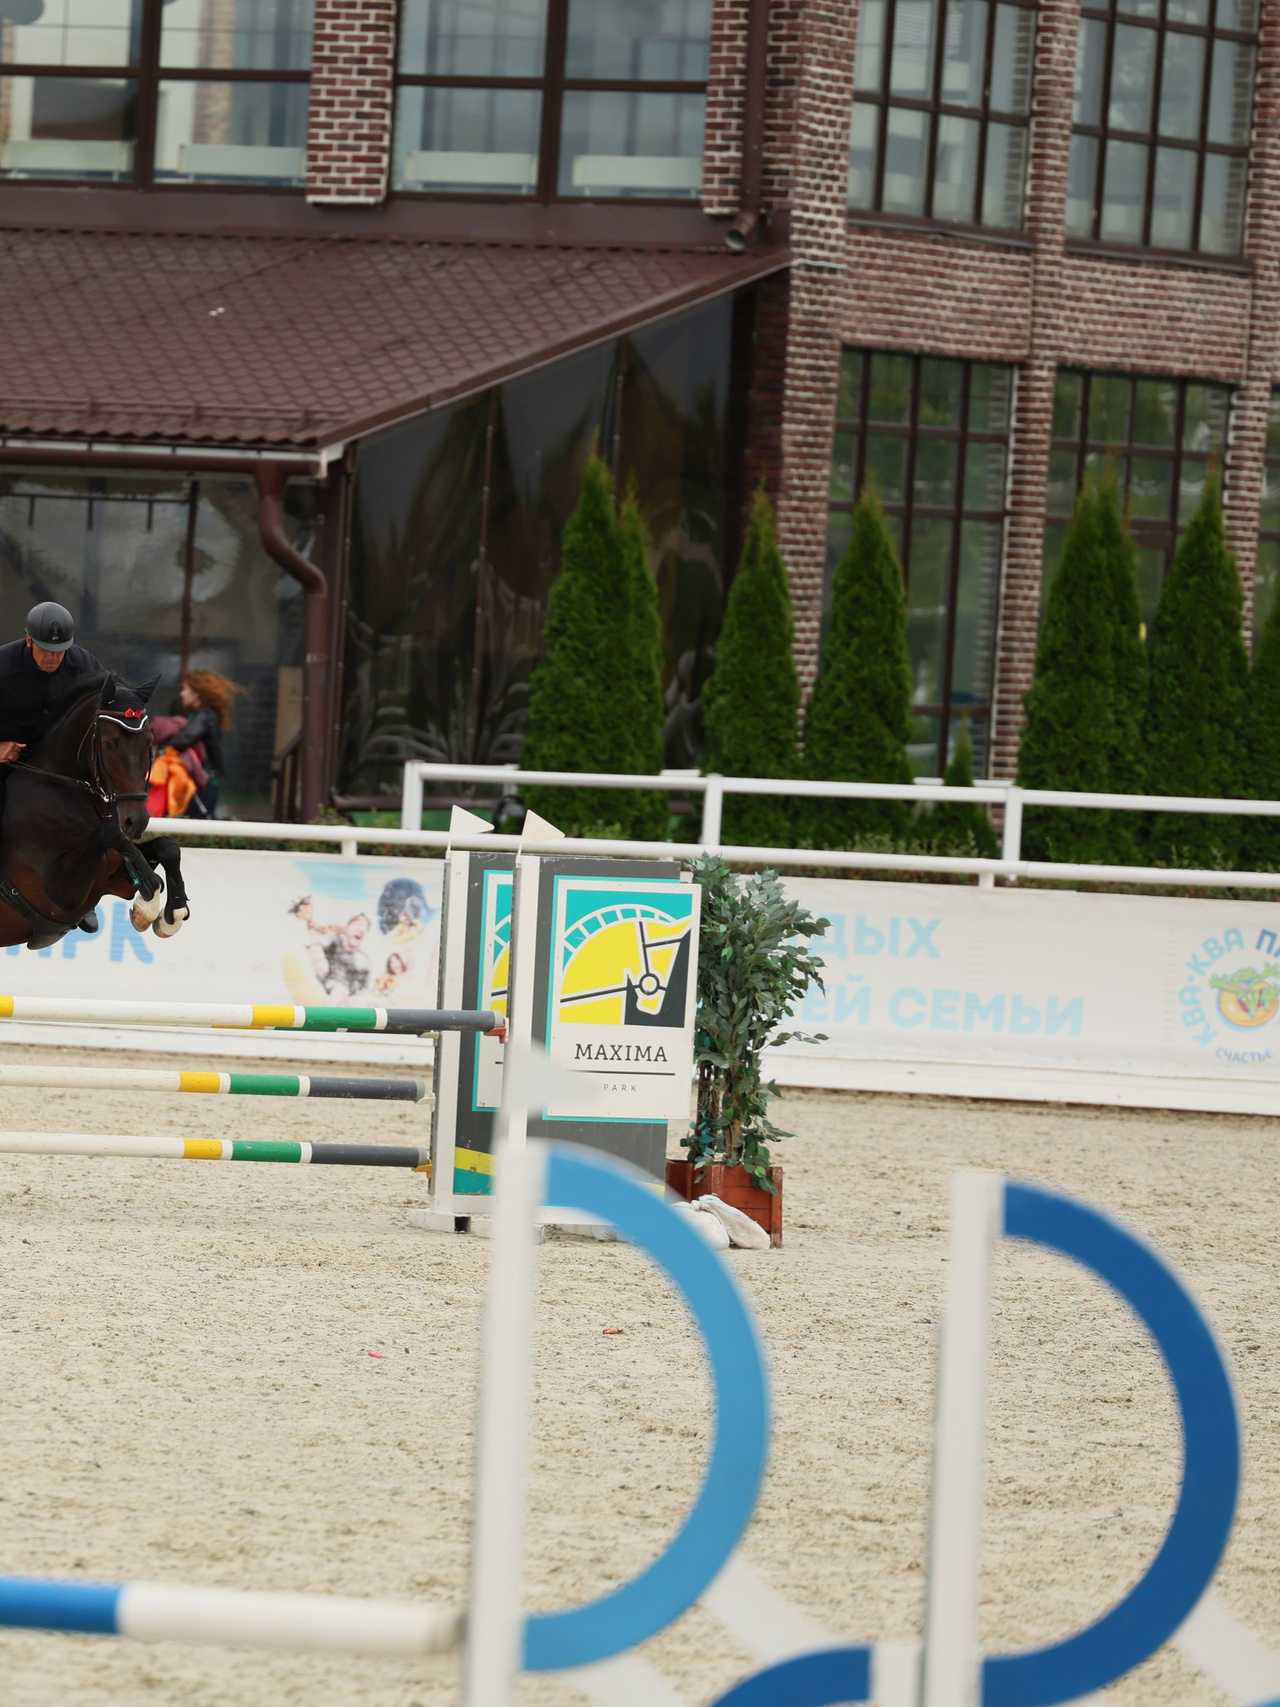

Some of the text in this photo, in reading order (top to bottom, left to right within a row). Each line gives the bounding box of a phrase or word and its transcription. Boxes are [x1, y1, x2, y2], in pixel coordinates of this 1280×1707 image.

[785, 913, 941, 960] ДЫХ
[785, 973, 1084, 1036] ЕЙ СЕМЬИ
[574, 1043, 668, 1063] MAXIMA
[1215, 1047, 1274, 1064] СЧАСТЬЕ
[603, 1083, 637, 1092] PARK
